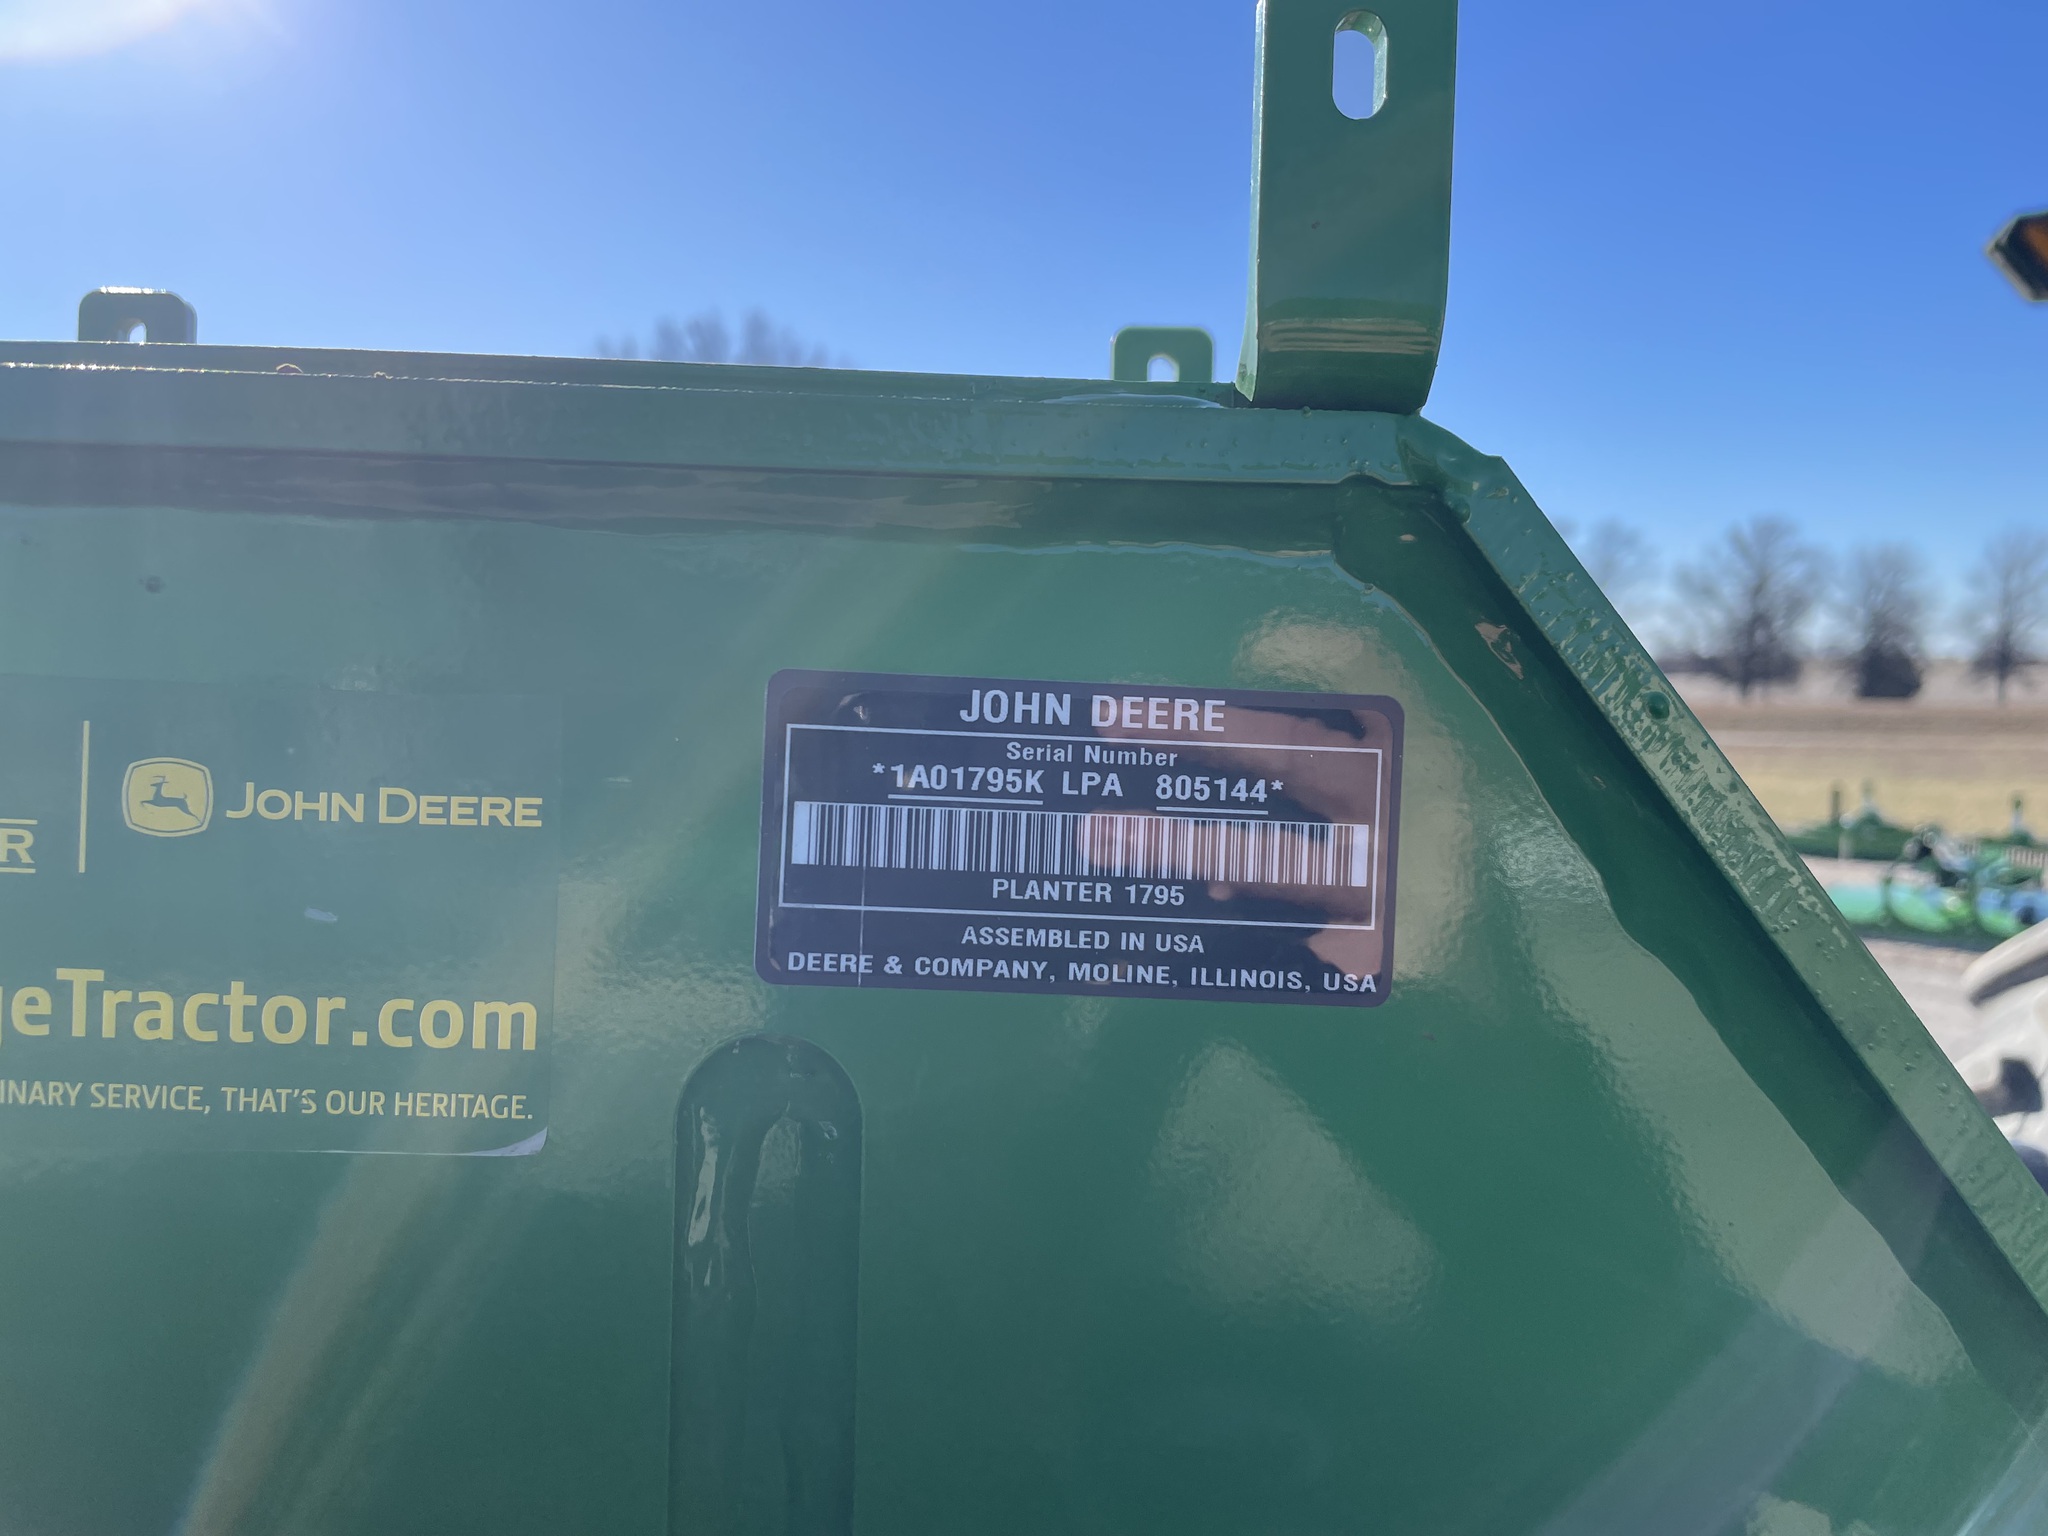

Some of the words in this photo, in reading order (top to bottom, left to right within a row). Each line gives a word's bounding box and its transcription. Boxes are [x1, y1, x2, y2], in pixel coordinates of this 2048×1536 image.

[958, 688, 1072, 725] JOHN
[1090, 693, 1227, 732] DEERE
[1005, 741, 1073, 763] Serial
[1083, 744, 1179, 767] Number
[1061, 770, 1124, 798] LPA
[225, 781, 365, 823] JOHN
[378, 786, 543, 828] DEERE
[991, 877, 1113, 904] PLANTER
[1124, 883, 1186, 907] 1795
[960, 925, 1111, 951] ASSEMBLED
[1120, 931, 1146, 952] IN
[1155, 932, 1205, 954] USA
[787, 951, 874, 975] DEERE
[883, 954, 903, 976] &
[913, 956, 1056, 984] COMPANY,
[1067, 961, 1179, 989] MOLINE,
[1190, 966, 1312, 994] ILLINOIS,
[1322, 972, 1378, 994] USA
[0, 966, 538, 1051] eTractor.com
[90, 1081, 212, 1115] SERVICE,
[325, 1088, 386, 1117] OUR
[394, 1091, 534, 1120] HERITAGE.
